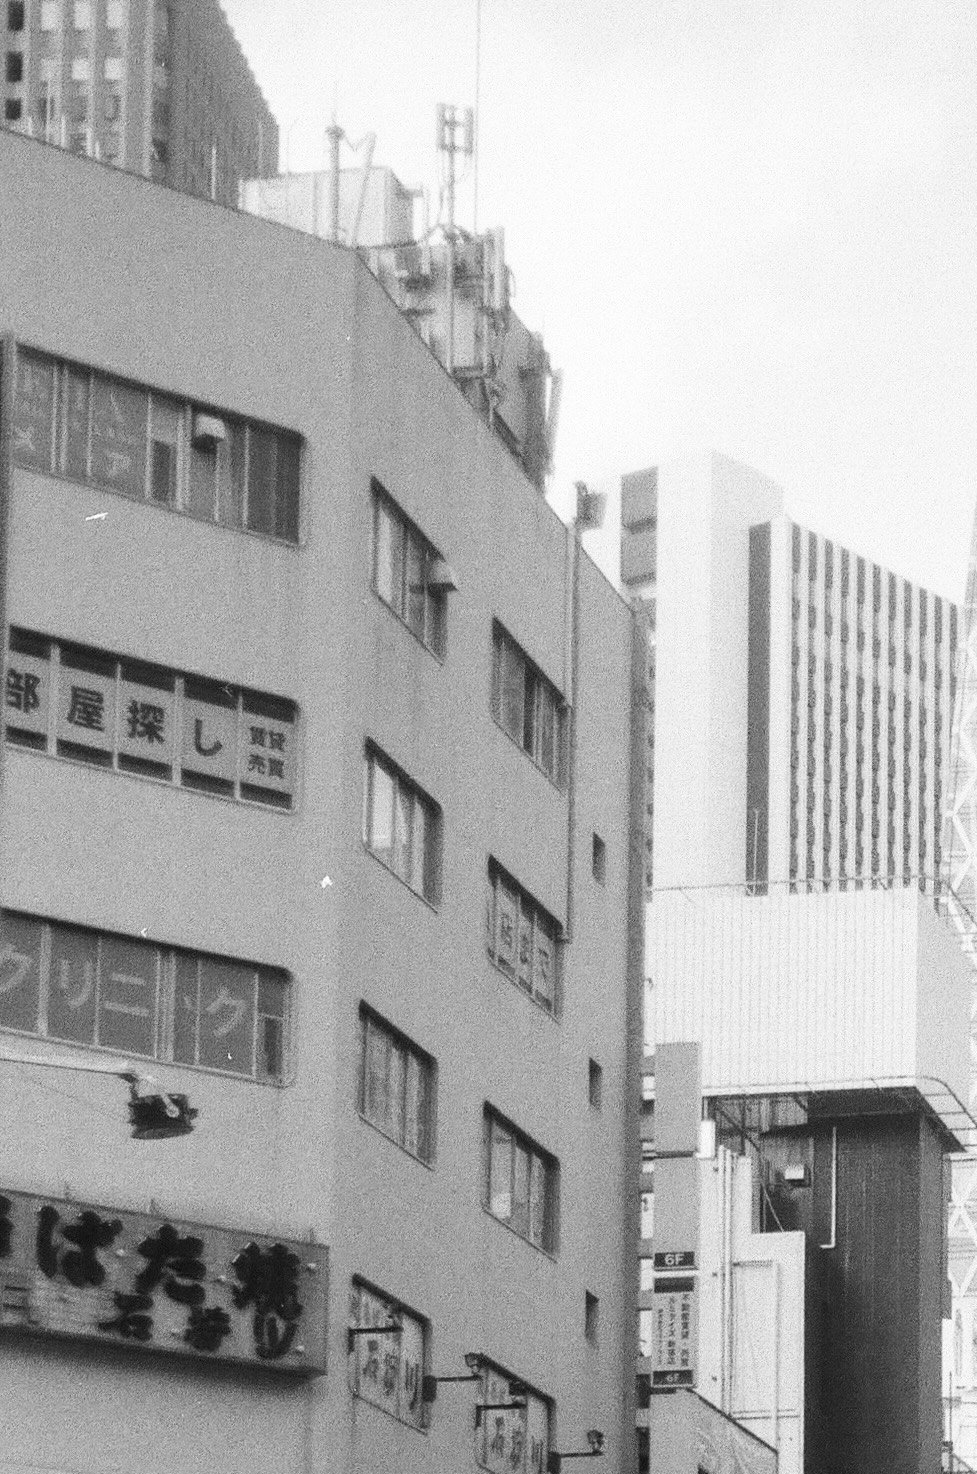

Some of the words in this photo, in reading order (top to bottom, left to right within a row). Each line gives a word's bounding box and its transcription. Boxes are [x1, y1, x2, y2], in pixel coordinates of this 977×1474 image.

[5, 667, 223, 758] 部屋探し
[664, 1253, 686, 1267] 6F
